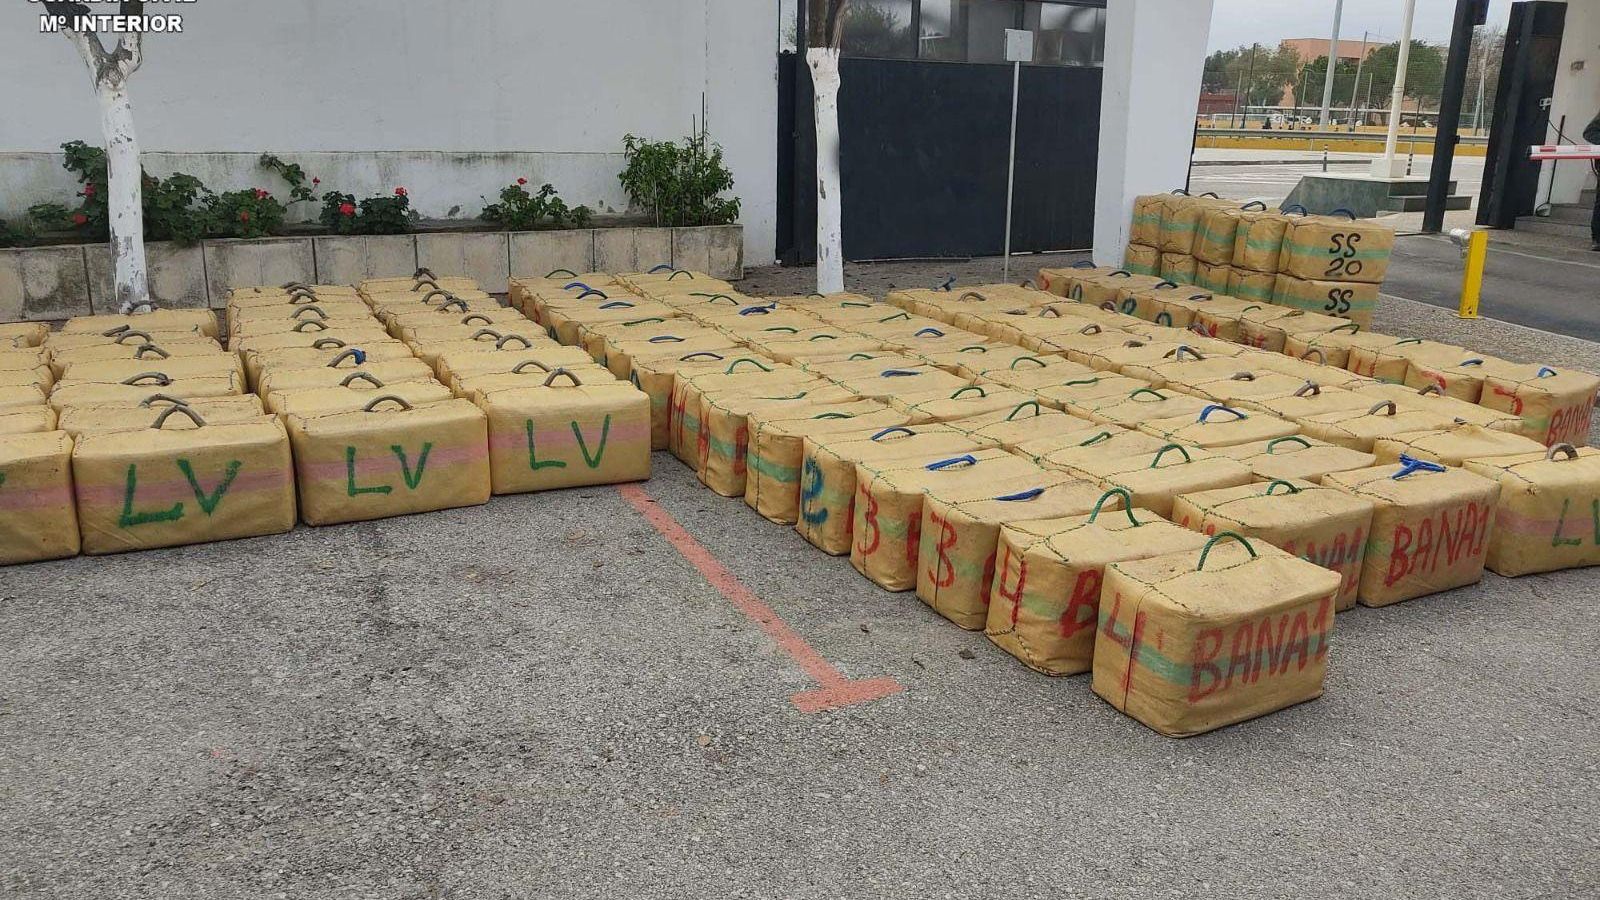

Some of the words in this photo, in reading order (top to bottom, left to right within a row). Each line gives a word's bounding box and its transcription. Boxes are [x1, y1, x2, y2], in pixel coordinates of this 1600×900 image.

[1324, 257, 1363, 276] 20
[1328, 232, 1361, 258] SS
[1324, 287, 1354, 314] SS
[347, 441, 433, 497] LV
[526, 414, 612, 471] LV
[118, 458, 242, 528] LV
[857, 482, 881, 556] 3
[928, 510, 957, 588] 3
[999, 544, 1027, 625] 4
